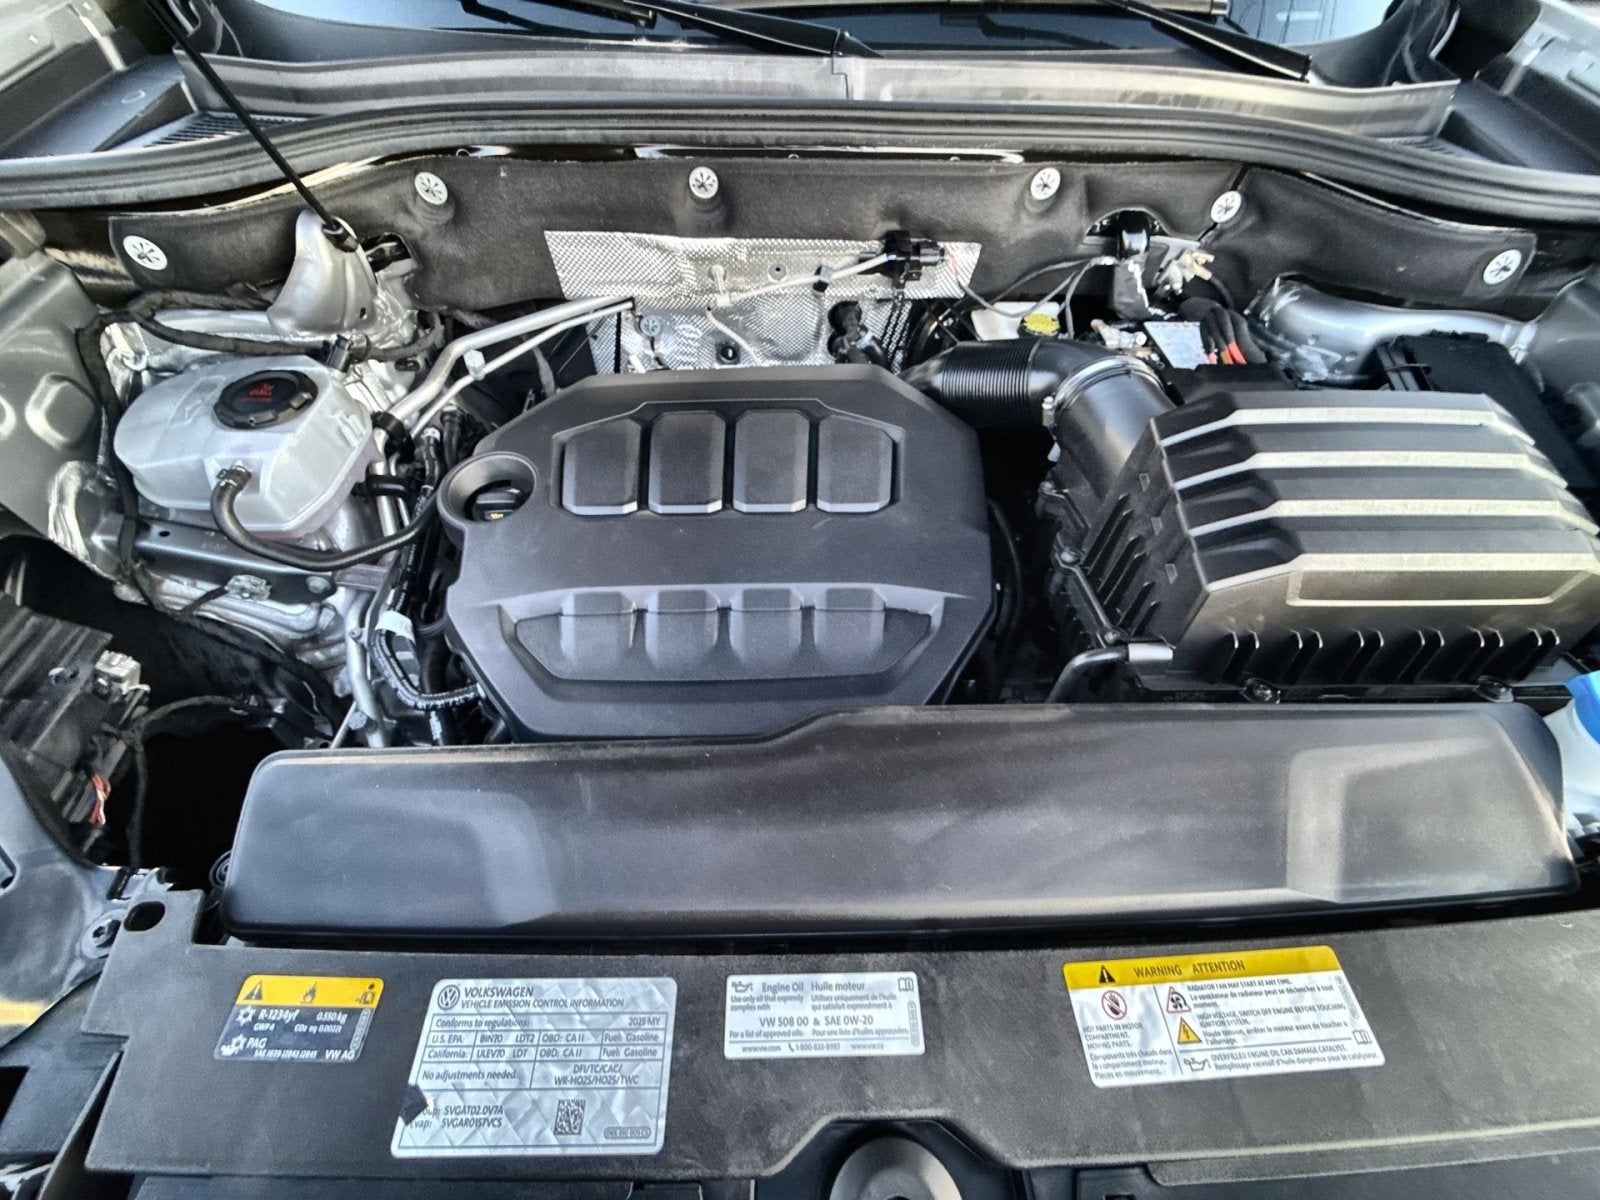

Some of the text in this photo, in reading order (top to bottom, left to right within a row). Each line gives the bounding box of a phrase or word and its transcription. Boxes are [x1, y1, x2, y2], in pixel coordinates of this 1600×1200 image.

[1134, 960, 1245, 978] WARNING ATTENTION
[762, 982, 804, 995] Engine Oil
[811, 981, 866, 991] Huile moteur
[464, 987, 534, 998] VOLKSWAGEN
[461, 999, 624, 1009] VEHICLE EMISSION CONTROL INFORMATION
[259, 1009, 300, 1024] R-1234yf
[337, 1012, 348, 1025] kg
[647, 1017, 661, 1026] MY
[760, 1015, 874, 1027] VW 508 00 & SAE 0W-20
[436, 1018, 530, 1029] Conforms to regulations:
[1122, 1022, 1143, 1030] MOTOR
[247, 1038, 268, 1049] PAG
[515, 1034, 535, 1043] LDT2
[542, 1034, 563, 1043] OBD:
[566, 1033, 577, 1043] CA
[605, 1033, 623, 1043] Fuel:
[626, 1033, 659, 1042] Gasoline
[325, 1050, 355, 1060] VW AG
[428, 1049, 469, 1059] California:
[513, 1049, 528, 1058] LDT
[540, 1049, 560, 1058] OBD:
[563, 1049, 575, 1058] CA
[602, 1048, 621, 1057] Fuel:
[624, 1048, 658, 1057] Gasoline
[423, 1070, 519, 1082] No adjustments needed.
